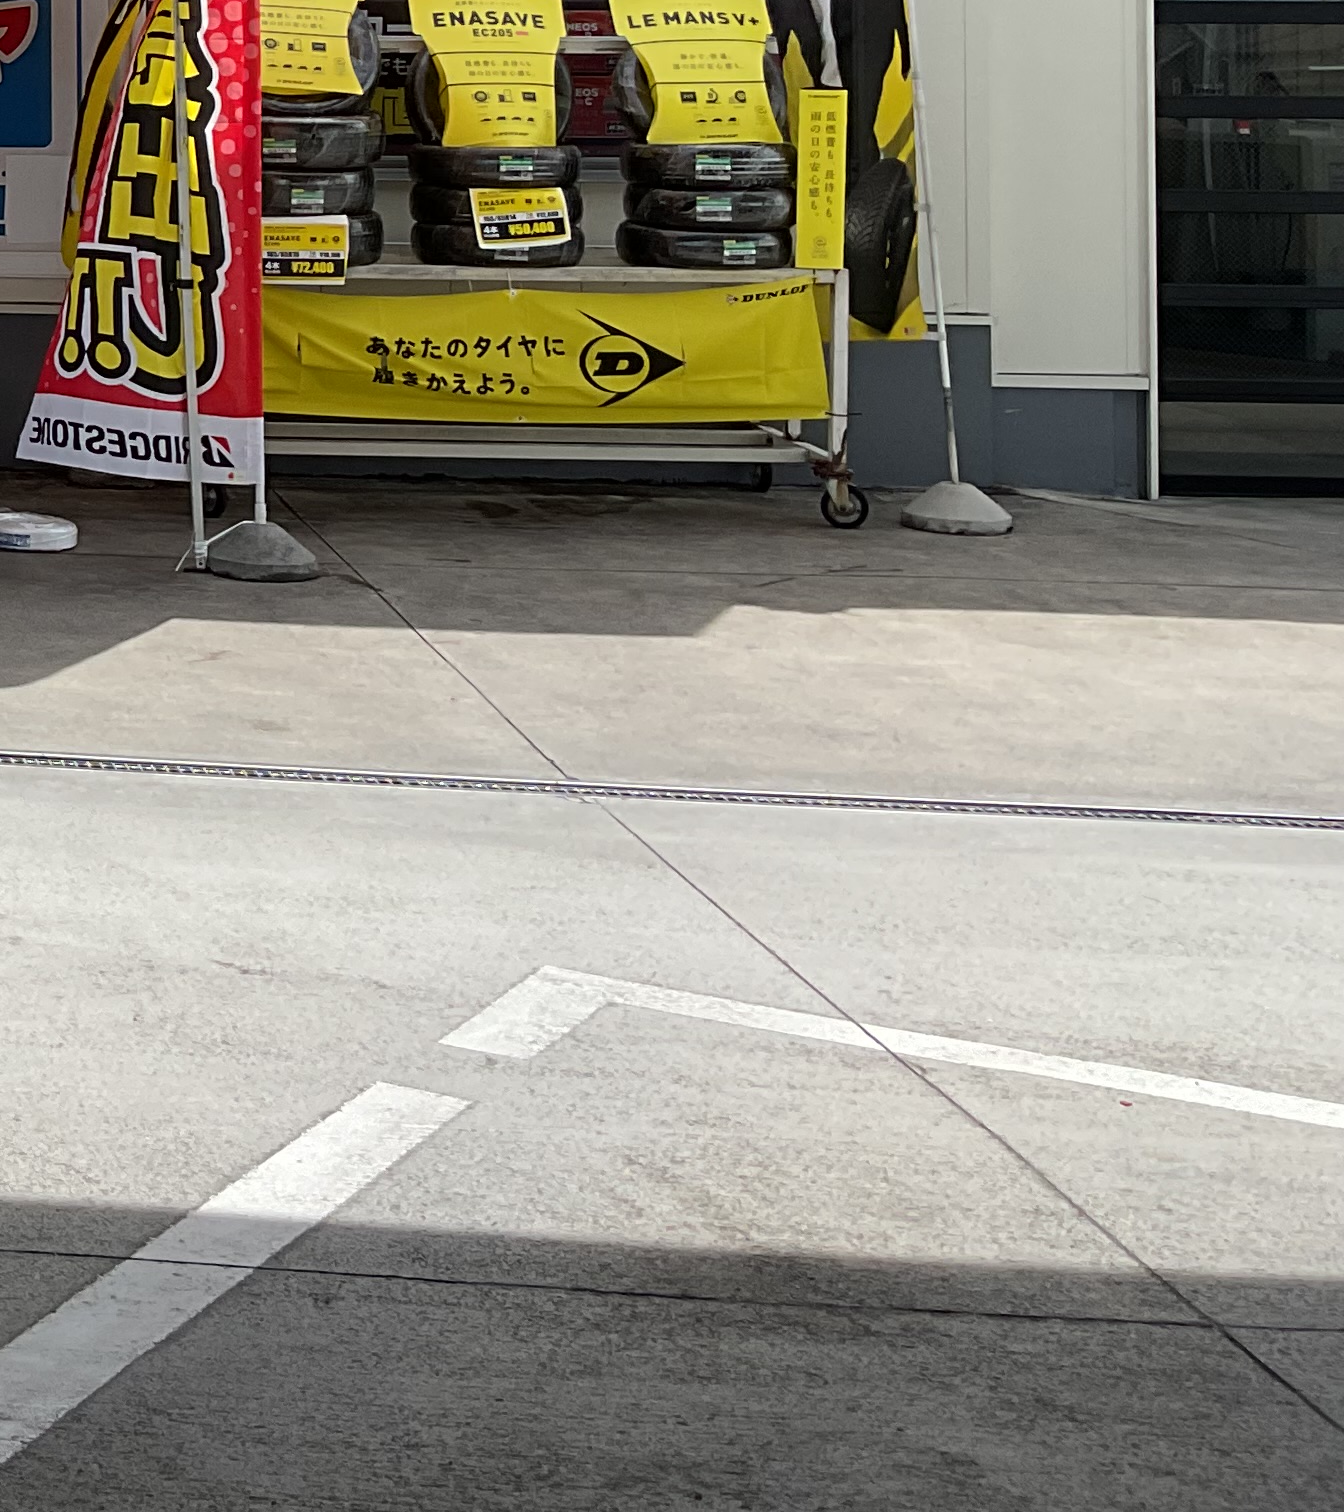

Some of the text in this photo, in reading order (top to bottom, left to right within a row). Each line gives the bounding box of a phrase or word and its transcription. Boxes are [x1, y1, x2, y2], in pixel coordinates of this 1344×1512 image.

[432, 11, 545, 29] ENASAVE
[628, 13, 657, 29] LE
[663, 11, 729, 26] MANS
[472, 28, 513, 37] EC205
[366, 336, 566, 358] あなたのタイヤに
